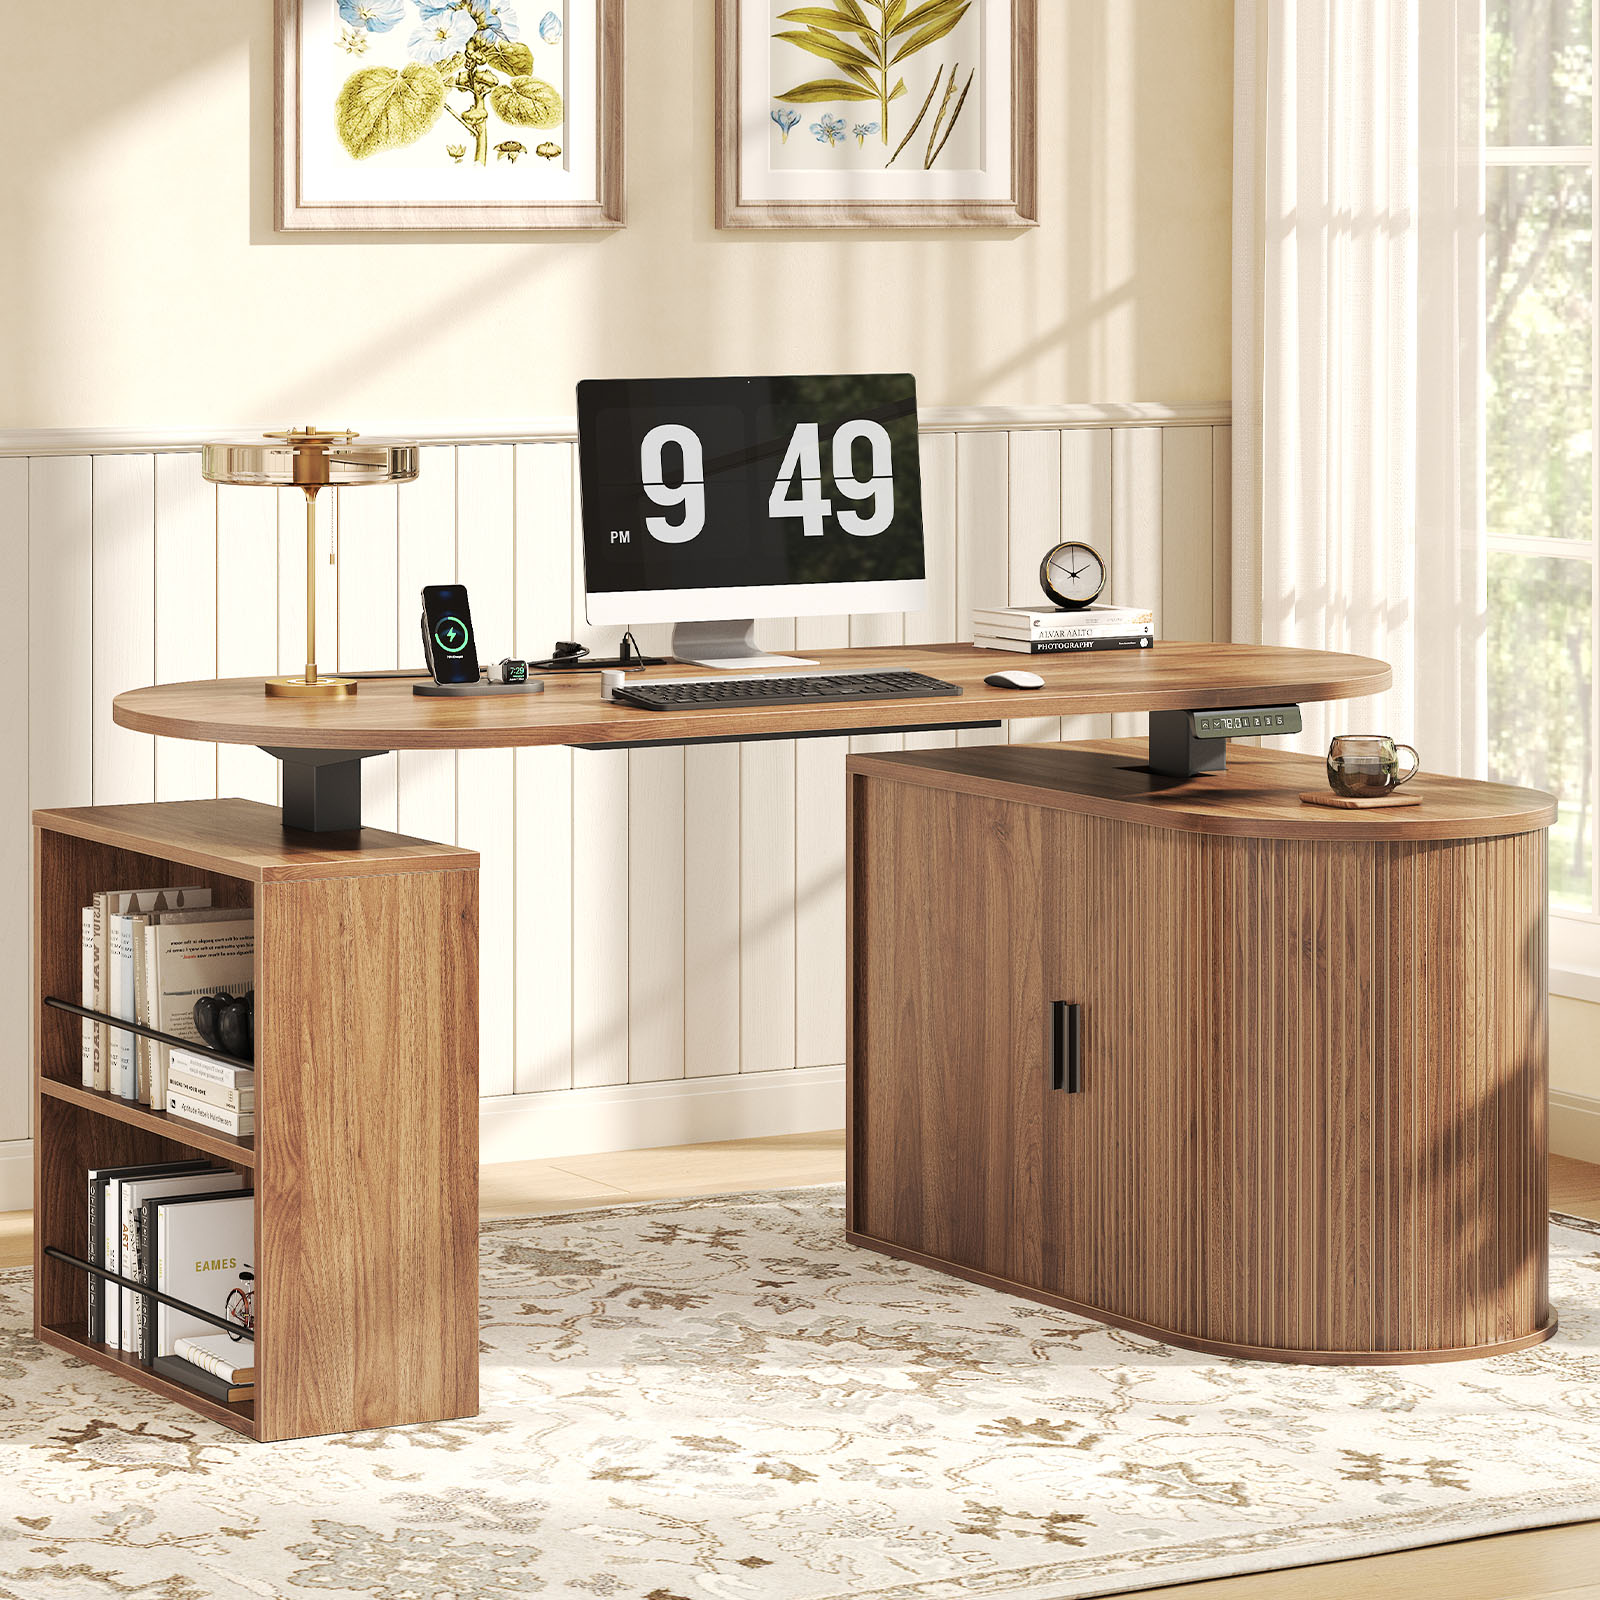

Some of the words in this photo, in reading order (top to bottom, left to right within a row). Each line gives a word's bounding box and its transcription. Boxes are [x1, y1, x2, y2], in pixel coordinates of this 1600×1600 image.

[640, 424, 706, 544] 9
[768, 419, 894, 536] 49
[610, 530, 630, 544] PM
[1038, 630, 1064, 638] ALVAR
[1037, 641, 1094, 650] PHOTOGRAPHY
[510, 666, 524, 674] 7:29
[195, 1258, 236, 1272] EAMES
